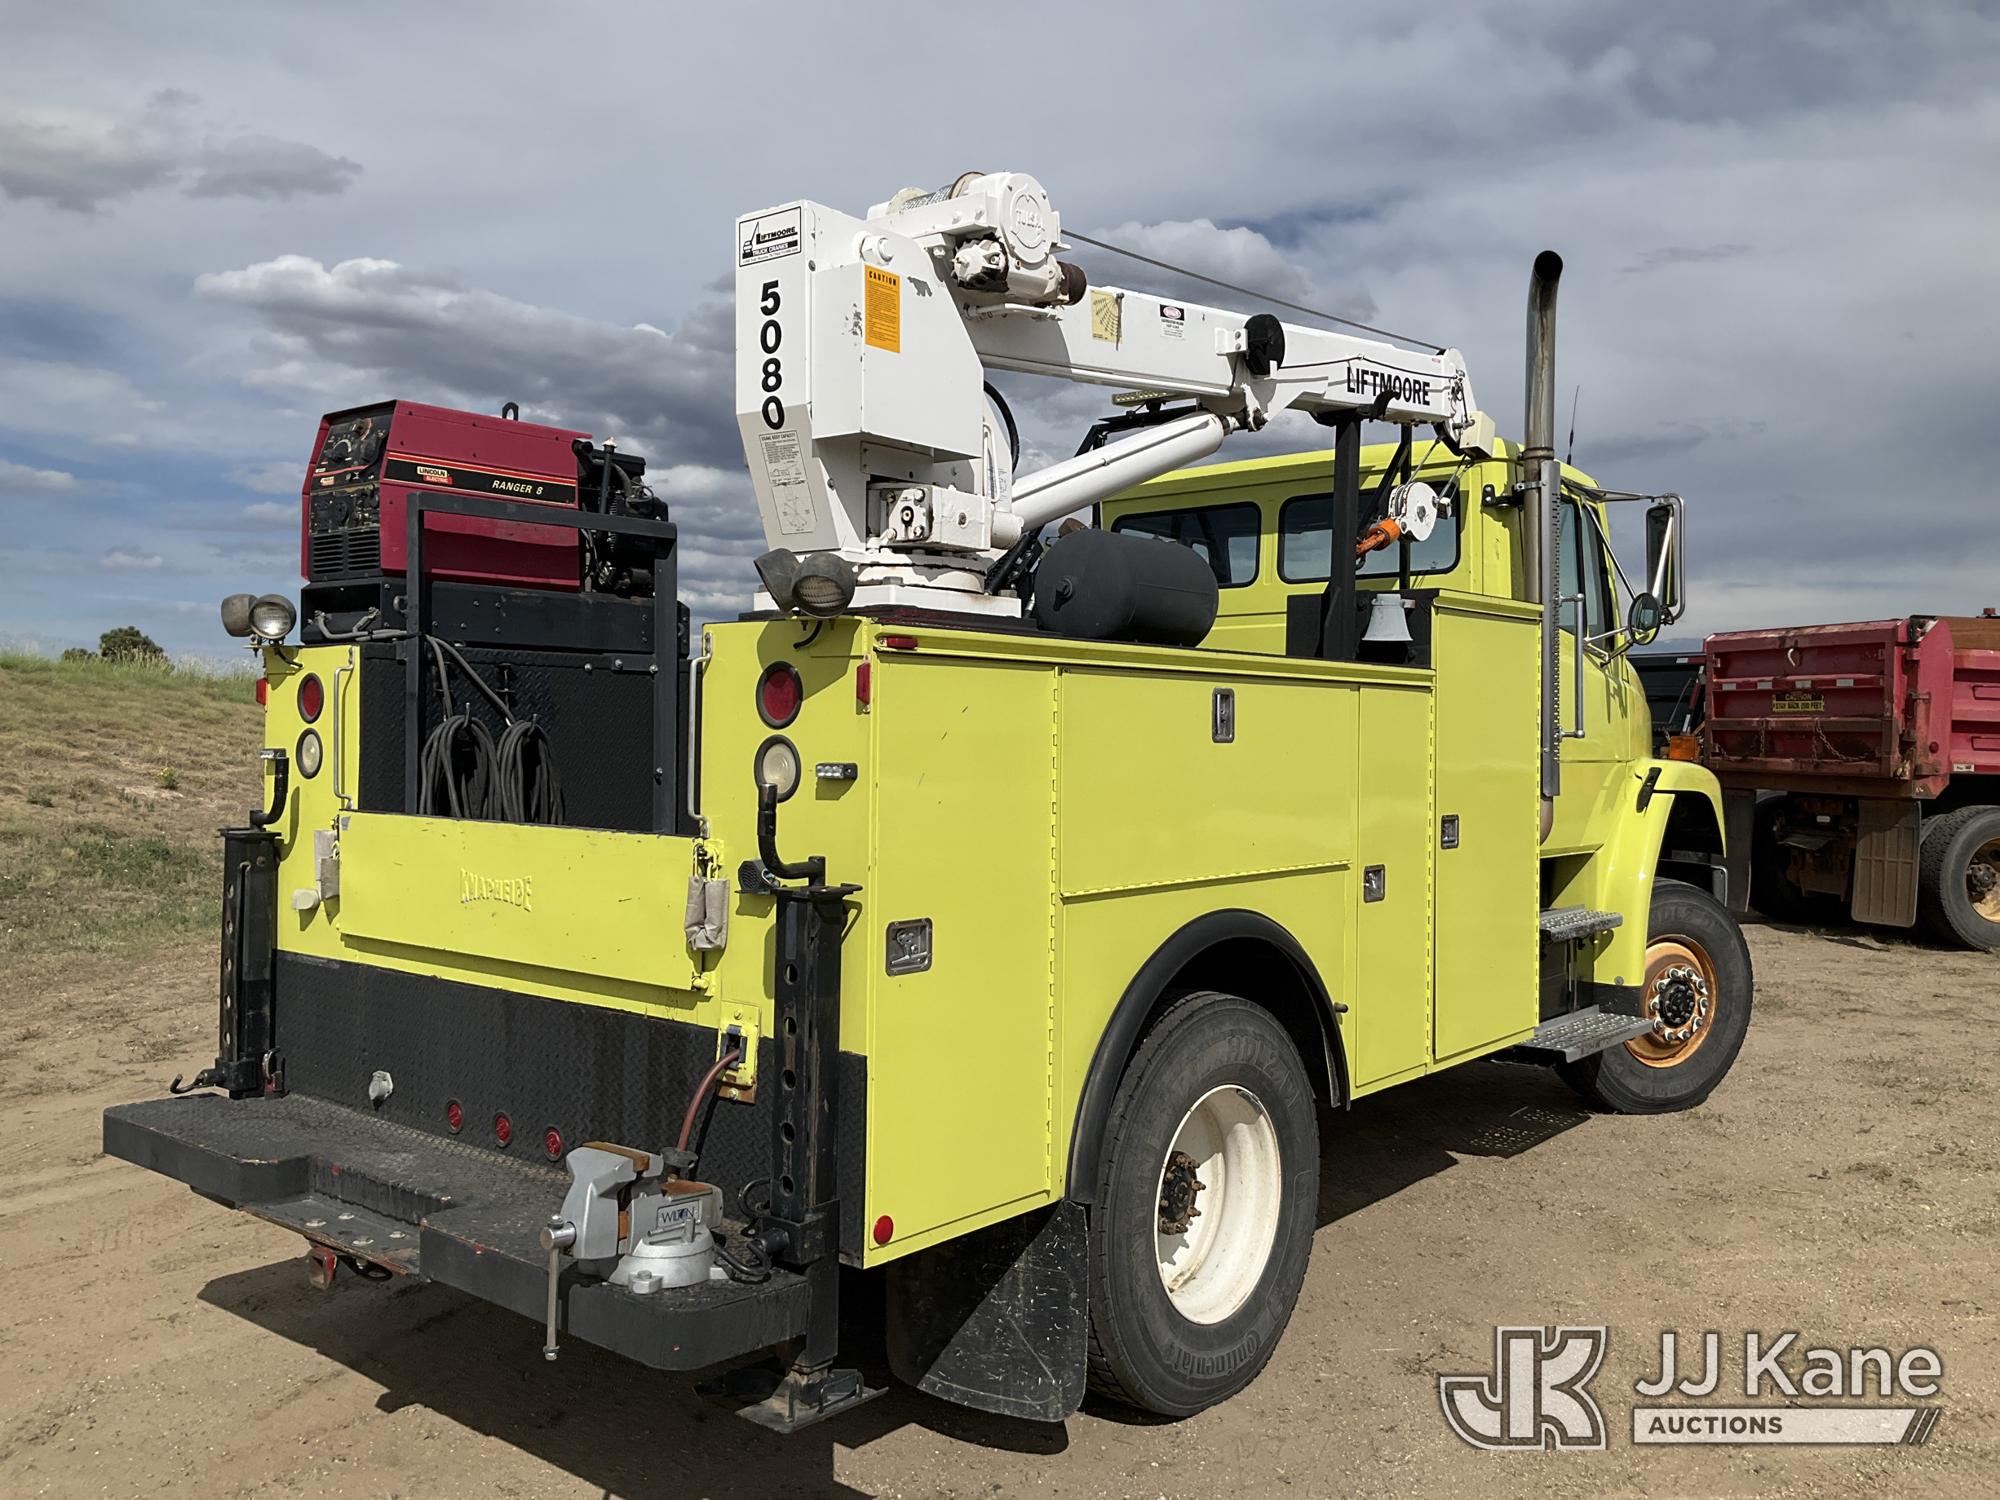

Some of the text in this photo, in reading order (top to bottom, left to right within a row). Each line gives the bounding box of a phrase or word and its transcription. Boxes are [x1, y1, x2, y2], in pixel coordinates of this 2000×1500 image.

[756, 226, 797, 245] LIFTMOORE
[869, 270, 897, 286] CAUTION
[760, 280, 785, 430] 5080
[1347, 366, 1430, 406] LIFTMOORE
[419, 467, 446, 476] LINCOLN
[492, 480, 544, 495] RANGER 8
